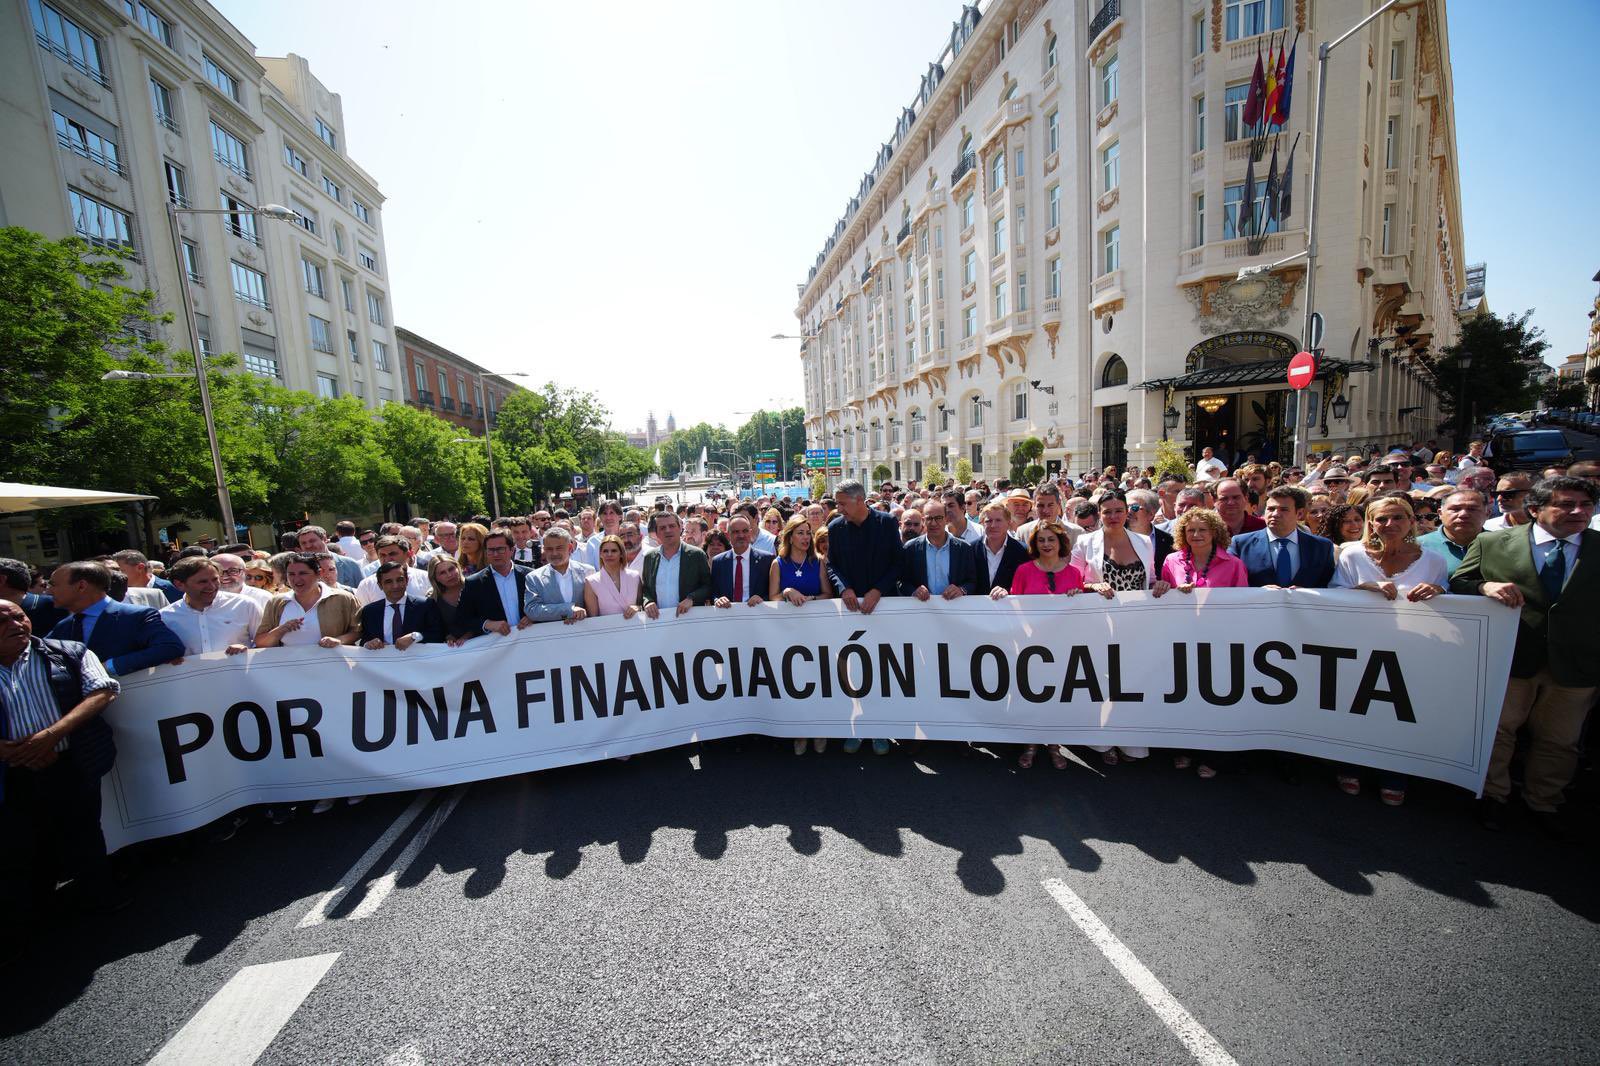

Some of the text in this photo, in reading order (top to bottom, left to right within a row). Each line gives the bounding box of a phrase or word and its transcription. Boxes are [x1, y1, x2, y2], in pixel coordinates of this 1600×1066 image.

[573, 475, 584, 489] P
[157, 629, 1417, 785] POR UNA FINANCIACIÓN LOCAL JUSTA
